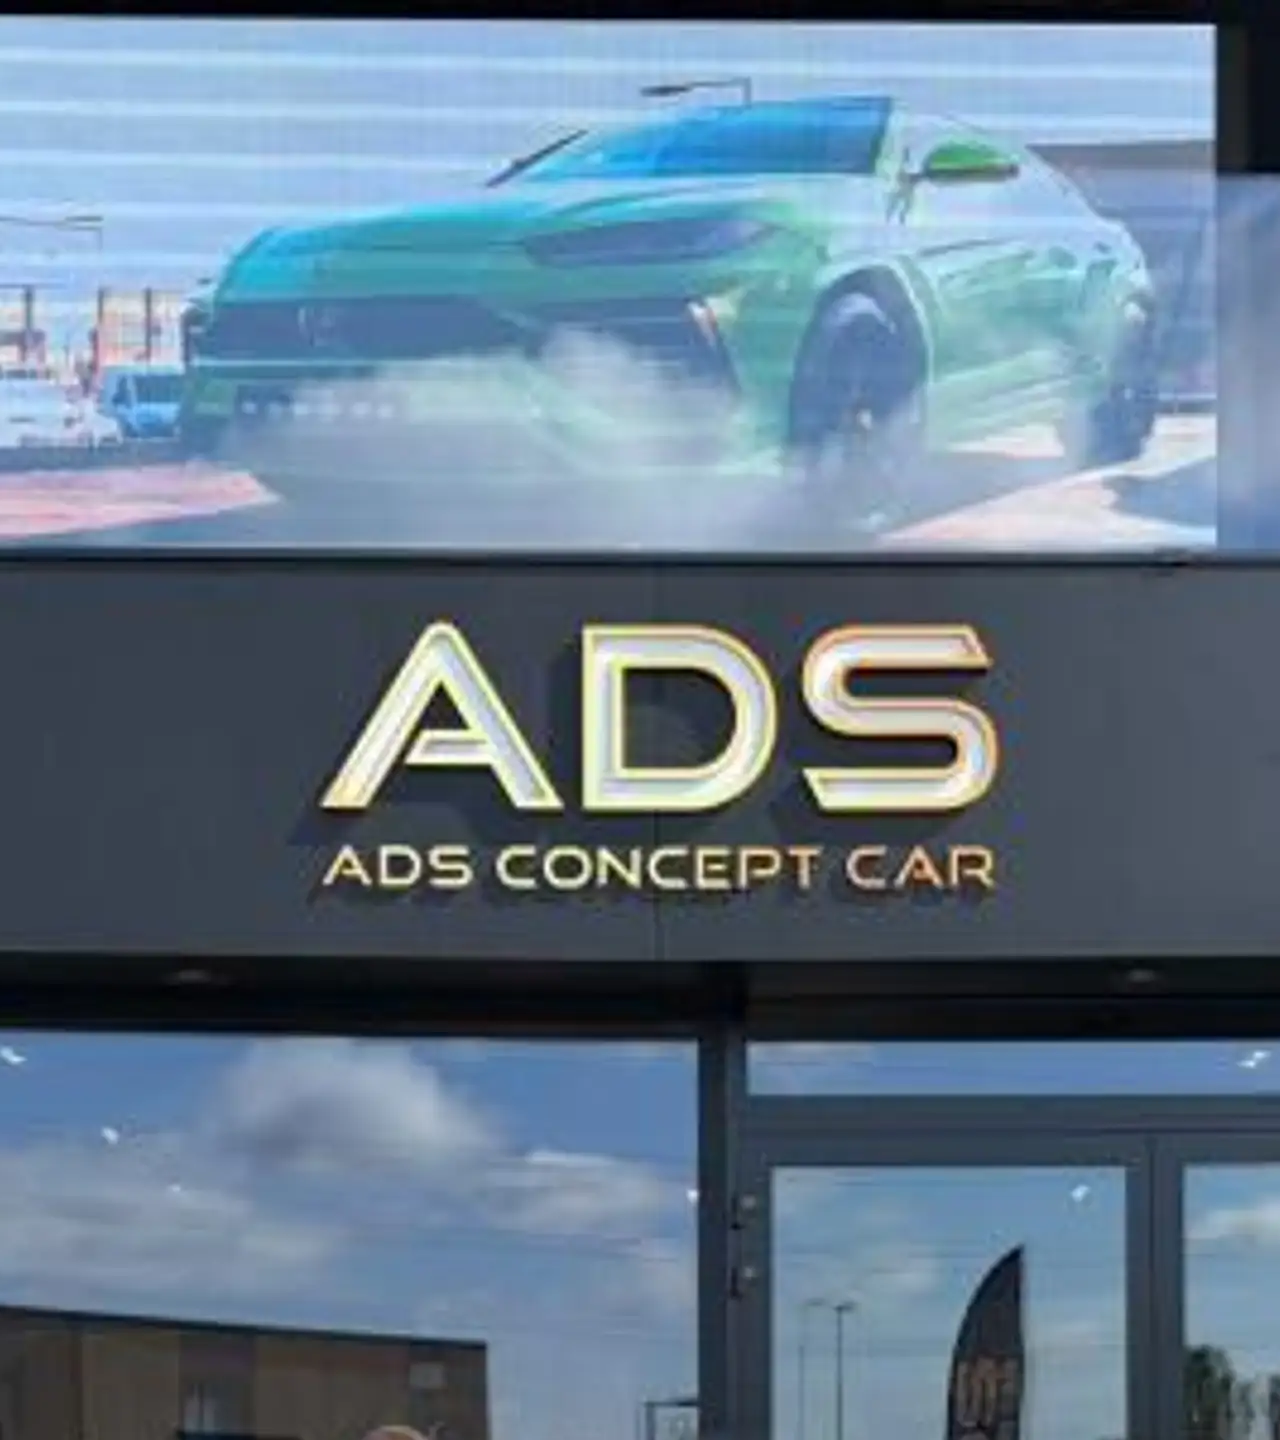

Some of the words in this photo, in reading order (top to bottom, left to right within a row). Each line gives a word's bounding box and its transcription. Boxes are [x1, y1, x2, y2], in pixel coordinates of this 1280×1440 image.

[320, 621, 1000, 811] ADS
[322, 844, 475, 889] ADS
[496, 844, 819, 890] CONCEPT
[846, 844, 995, 889] CAR
